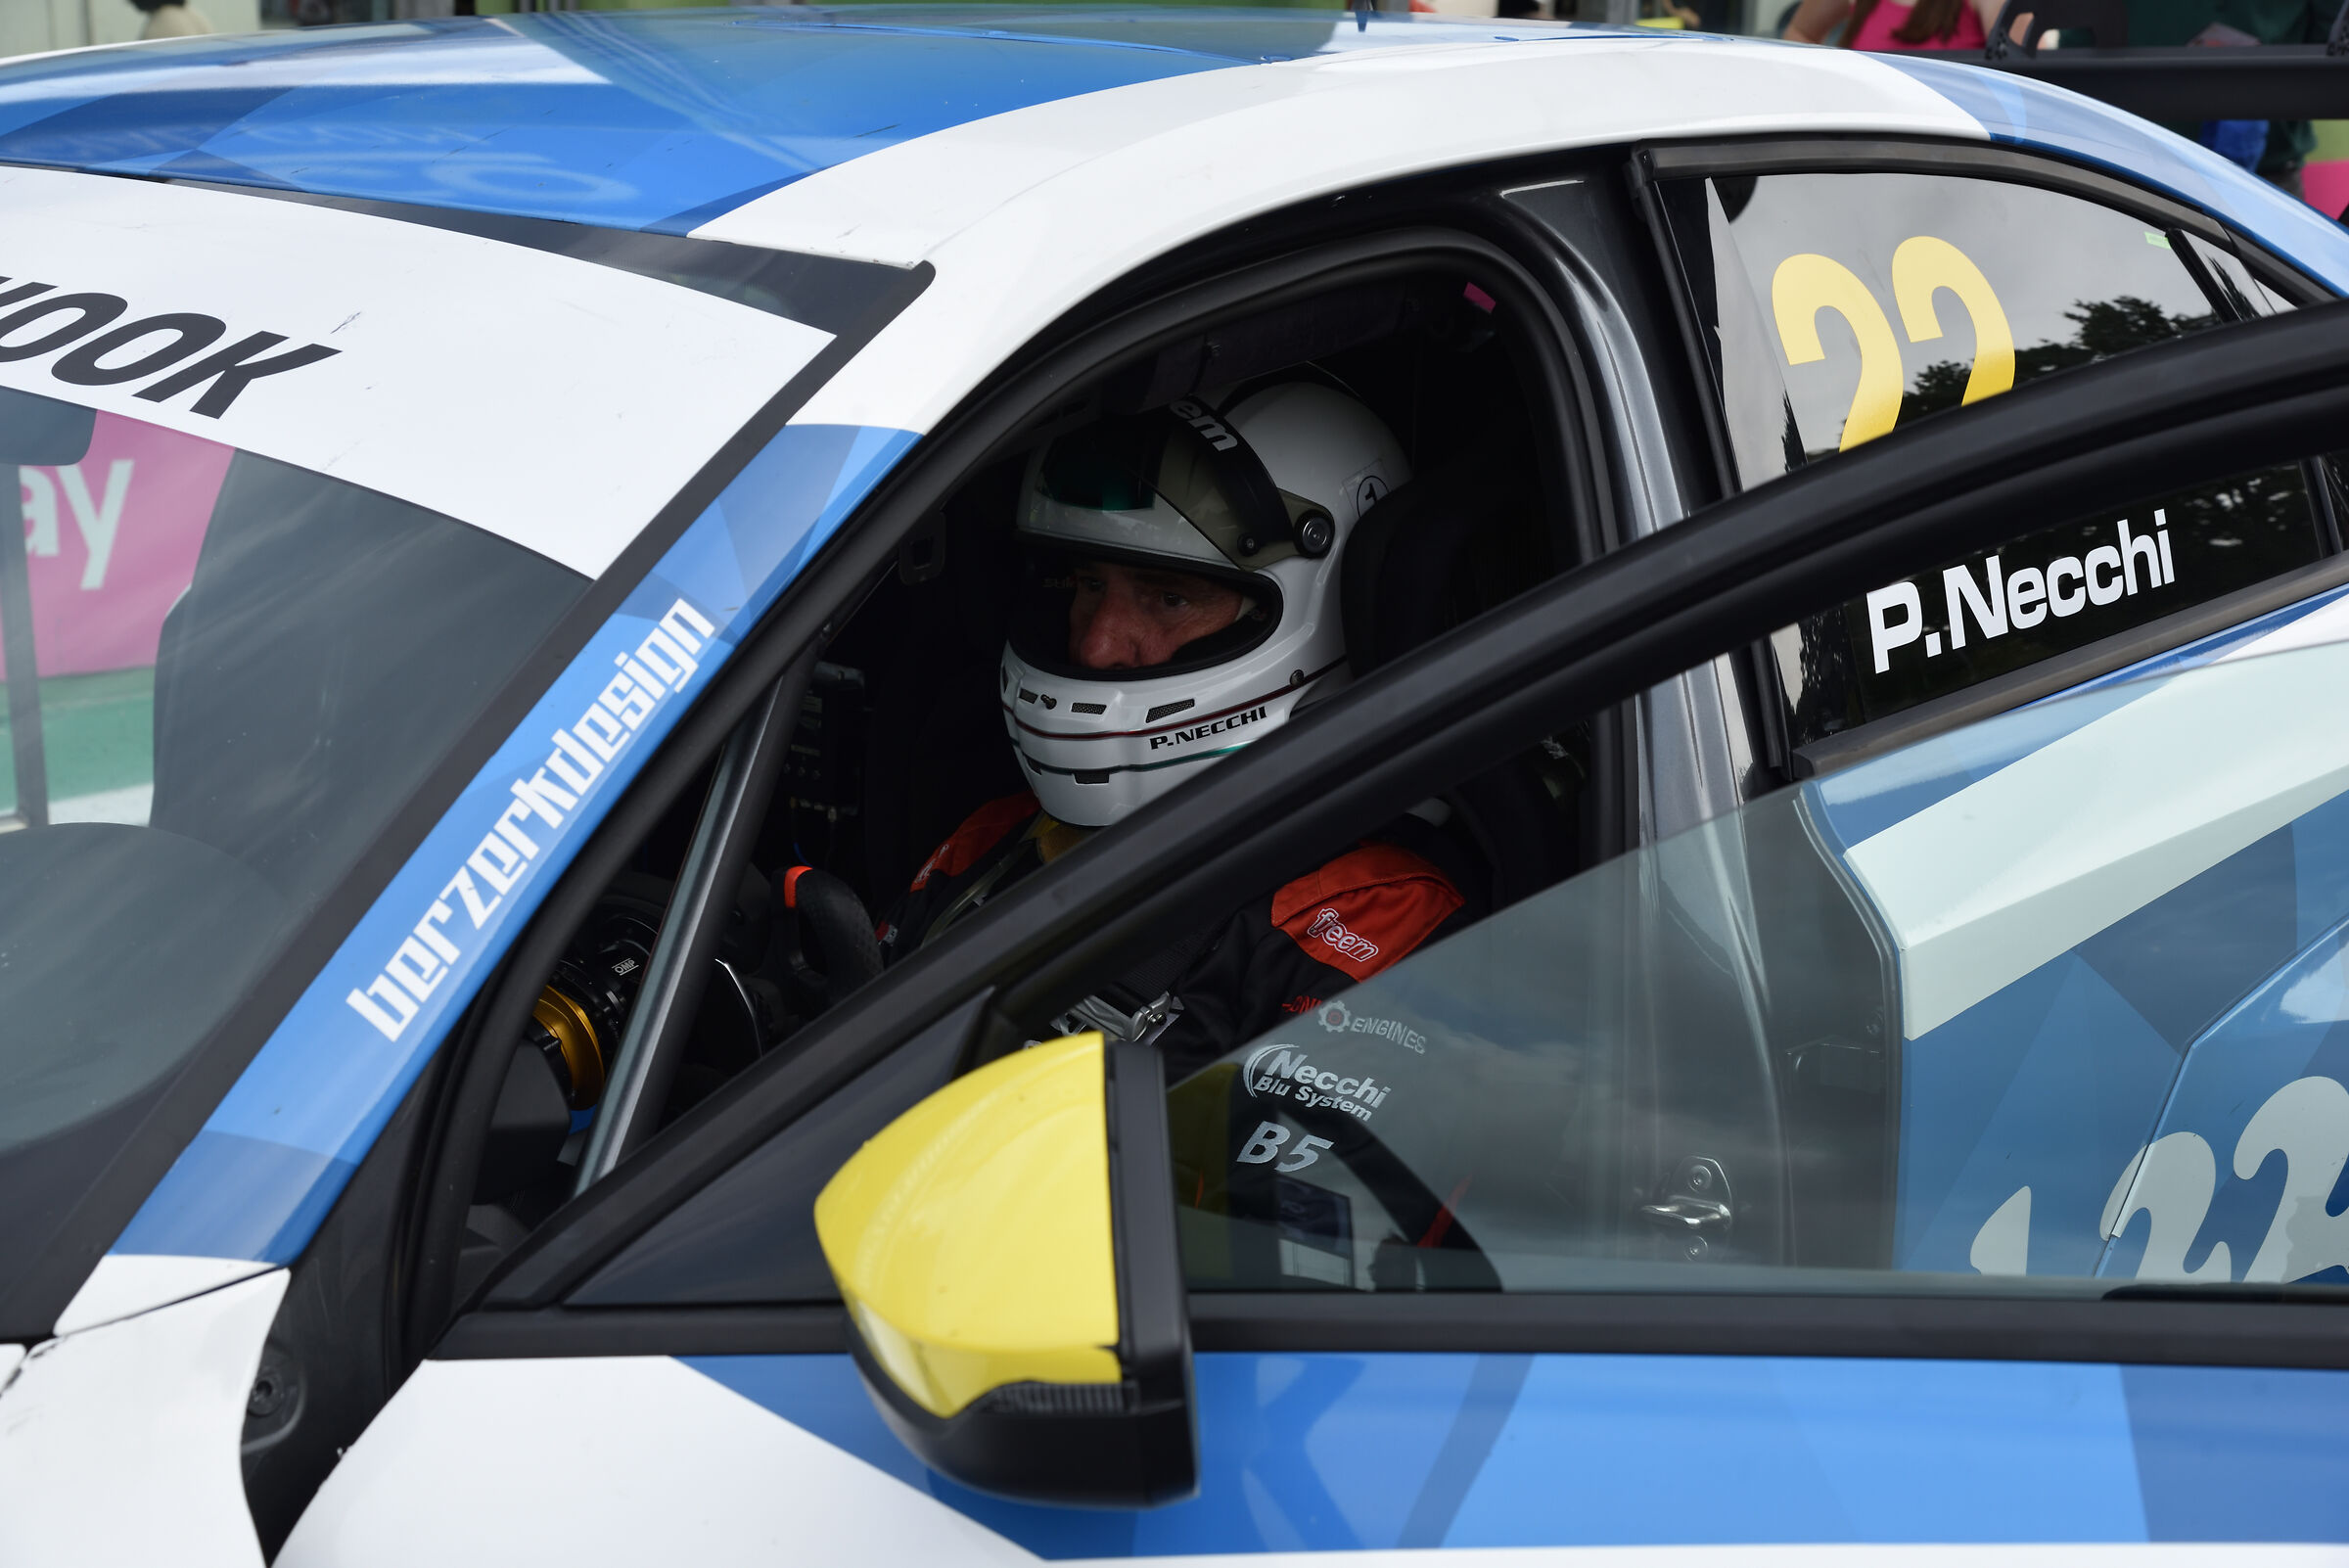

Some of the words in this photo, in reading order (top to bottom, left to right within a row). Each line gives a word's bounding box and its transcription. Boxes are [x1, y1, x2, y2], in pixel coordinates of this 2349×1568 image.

[0, 276, 343, 420] OOK
[1866, 508, 2175, 674] P.Necchi
[1149, 706, 1267, 750] P.NECCHI
[345, 598, 715, 1042] berzerkdesign
[1309, 908, 1378, 962] freem
[613, 958, 638, 976] OMP
[1350, 1017, 1426, 1055] ENGINES
[1254, 1076, 1291, 1096] Blu
[1295, 1084, 1372, 1122] System
[1265, 1050, 1392, 1109] Necchi
[1235, 1120, 1335, 1173] B5
